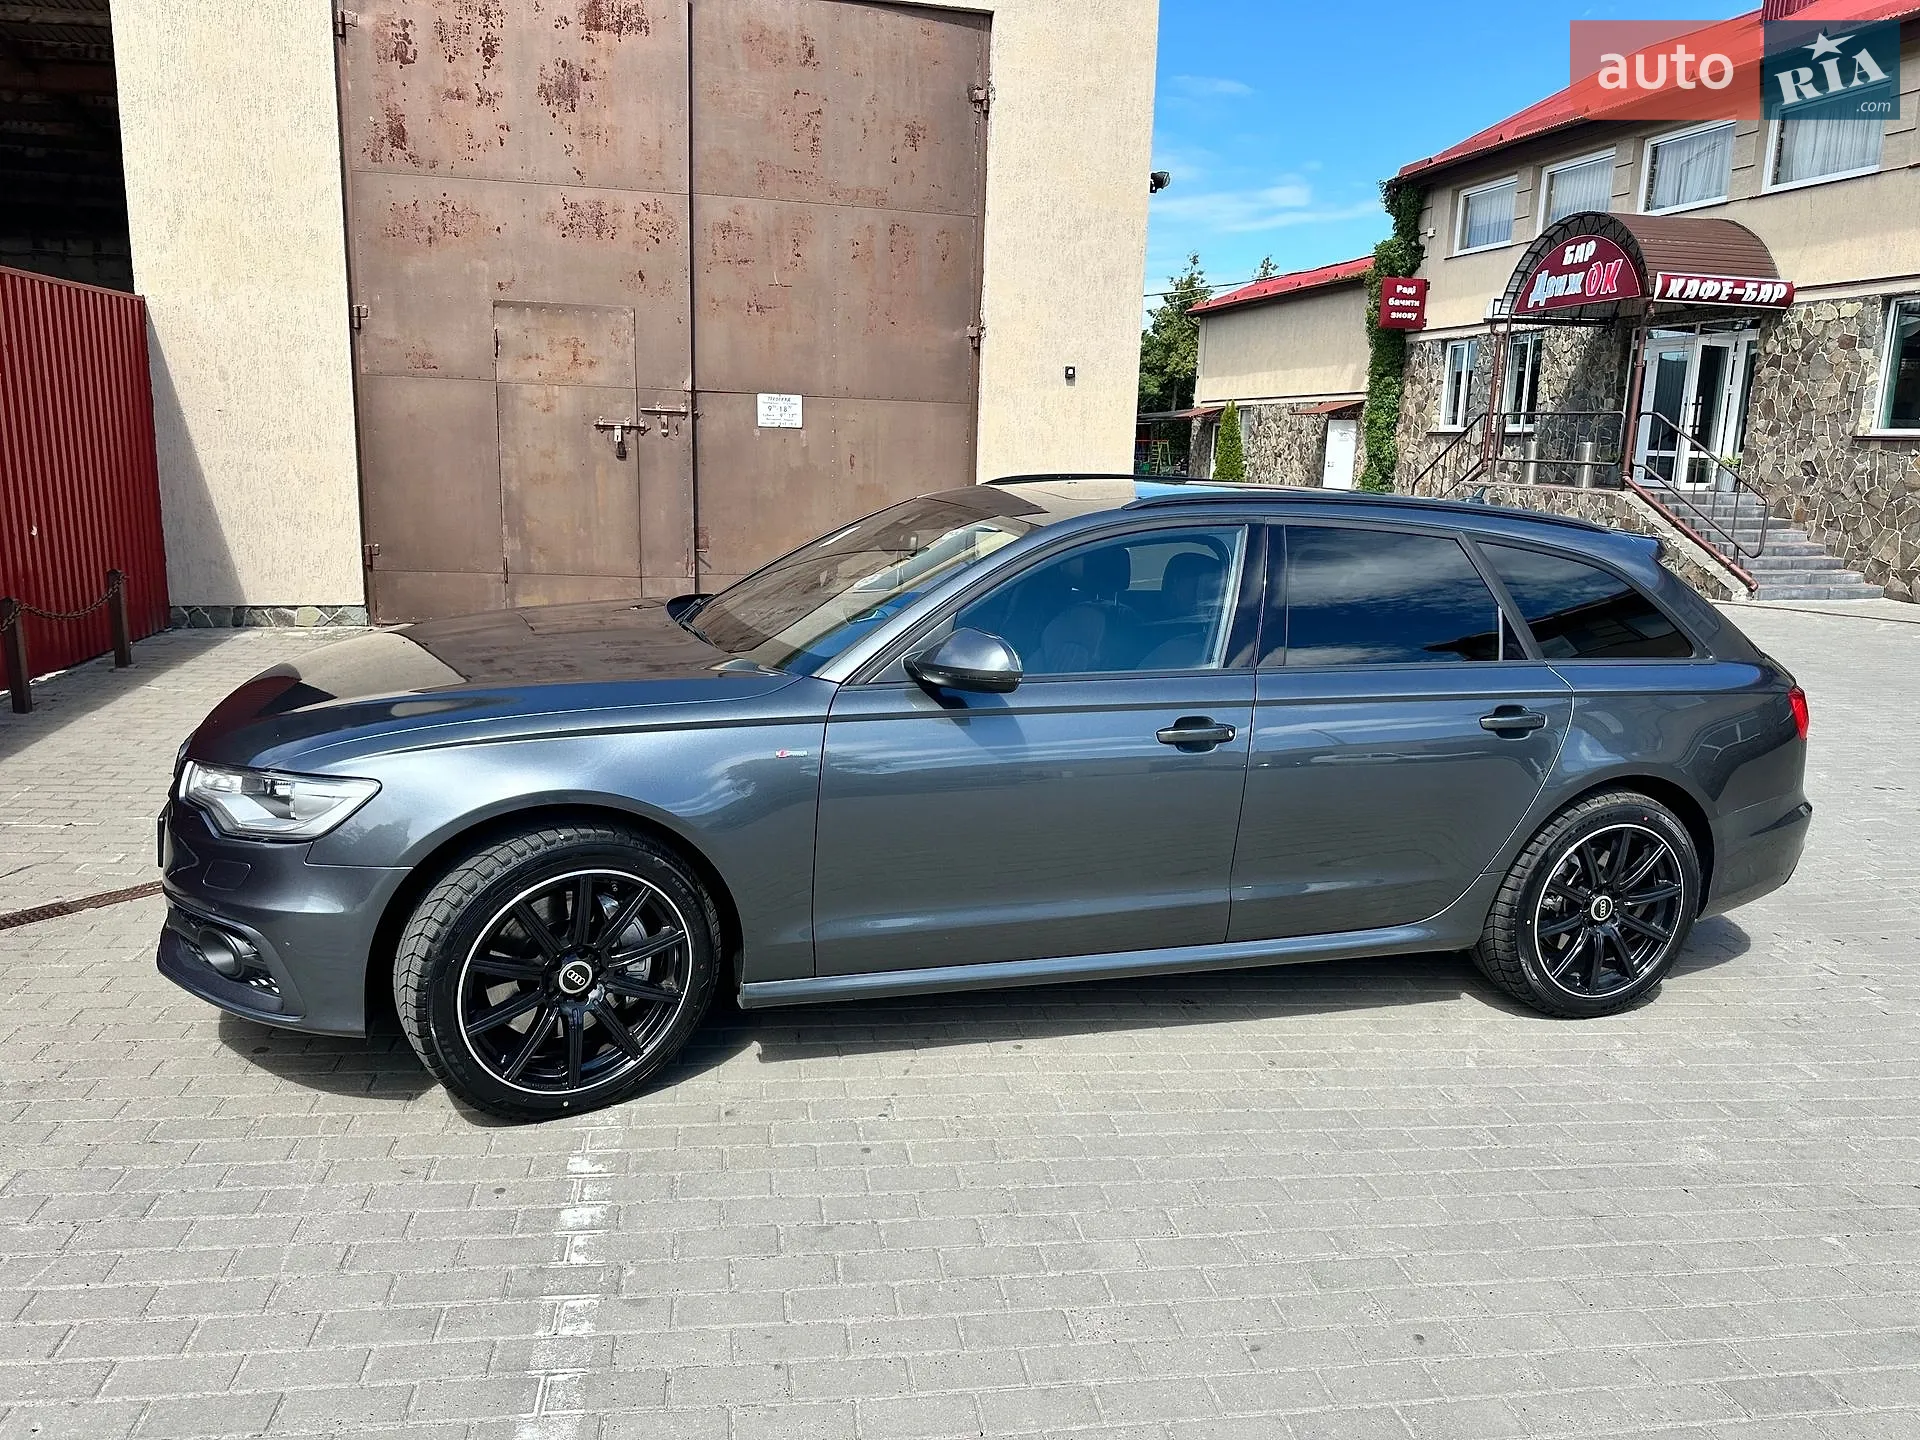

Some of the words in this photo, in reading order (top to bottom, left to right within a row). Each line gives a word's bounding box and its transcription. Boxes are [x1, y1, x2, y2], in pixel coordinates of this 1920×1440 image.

[1562, 239, 1597, 266] БАР
[1396, 284, 1416, 295] Раді
[1665, 277, 1788, 304] КАФЕ-БАР
[1388, 297, 1420, 307] бачити
